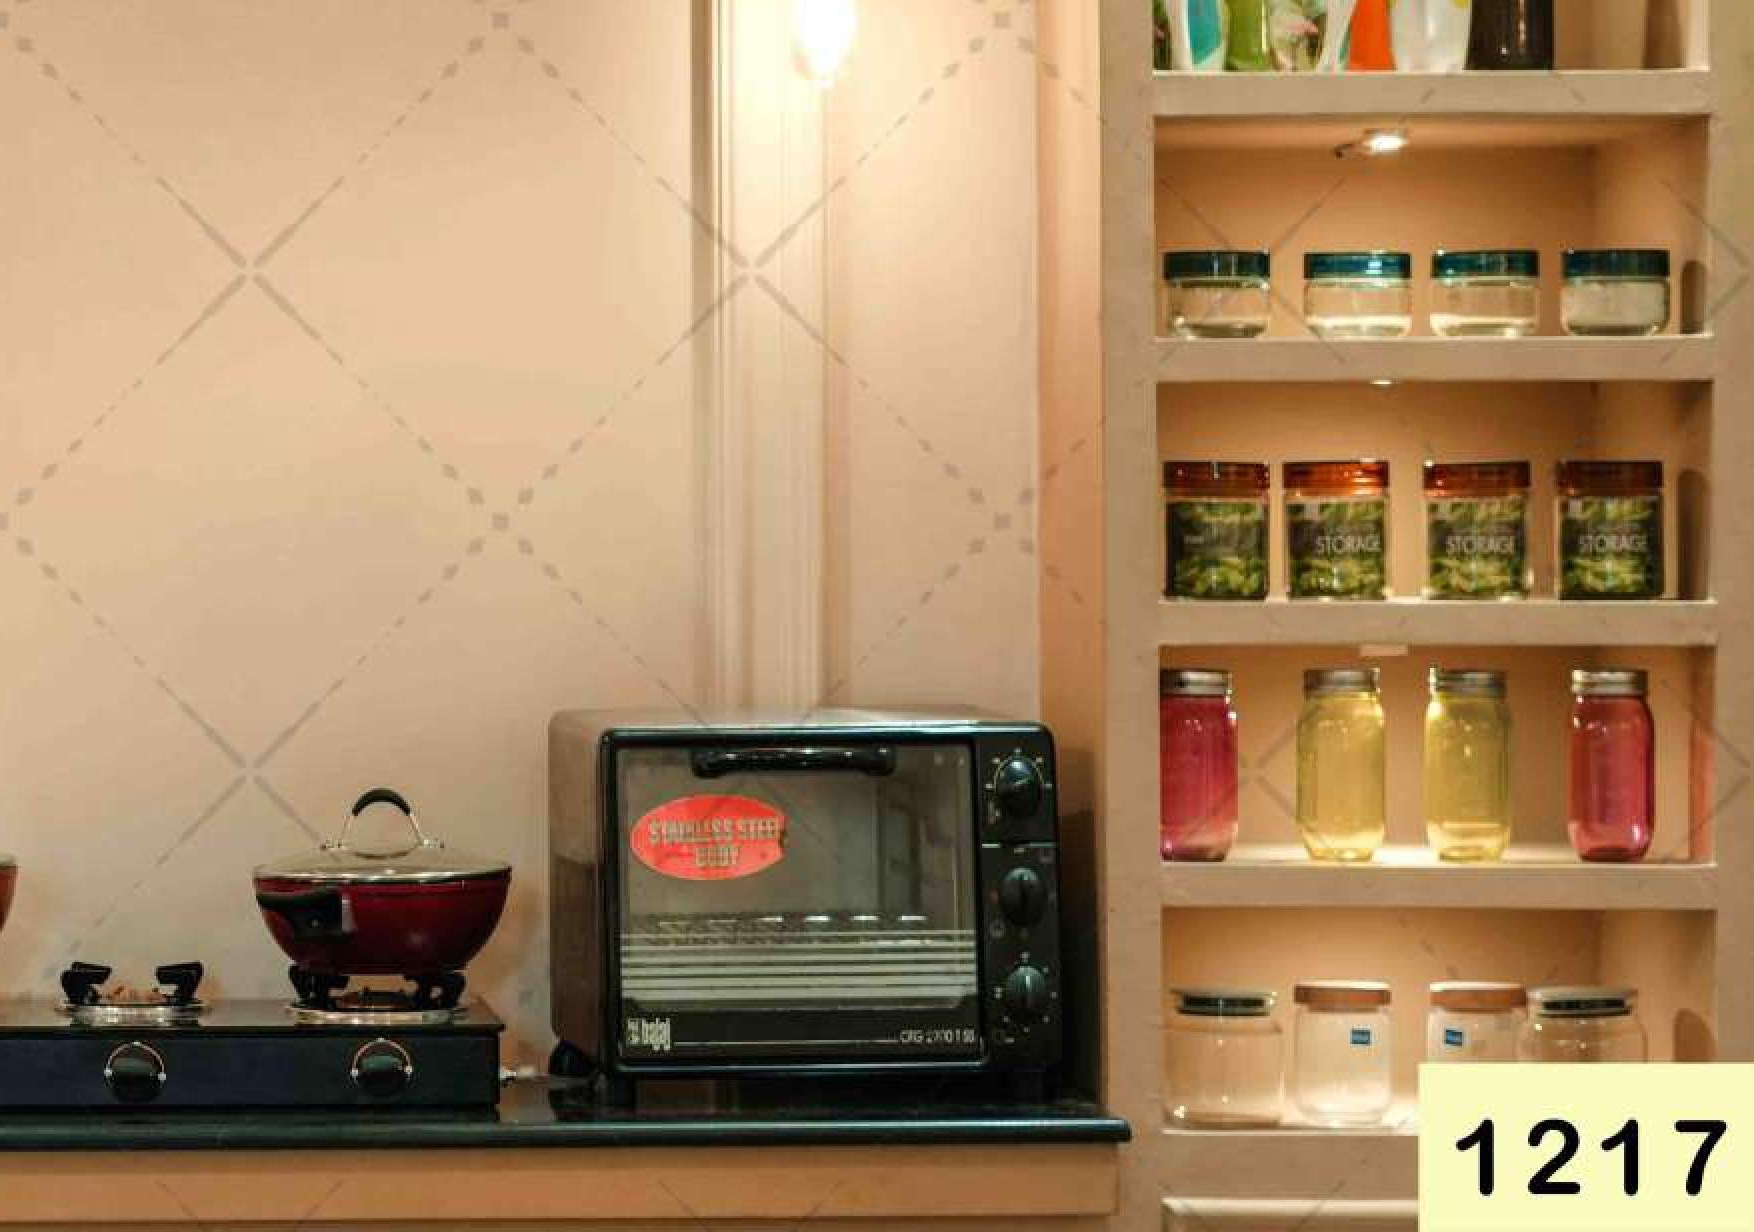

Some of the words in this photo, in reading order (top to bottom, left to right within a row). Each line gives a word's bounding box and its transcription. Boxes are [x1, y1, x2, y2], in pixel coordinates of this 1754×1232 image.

[1315, 534, 1382, 555] STORAGE
[1445, 534, 1515, 555] STORAGE
[1578, 533, 1646, 554] STORAGE
